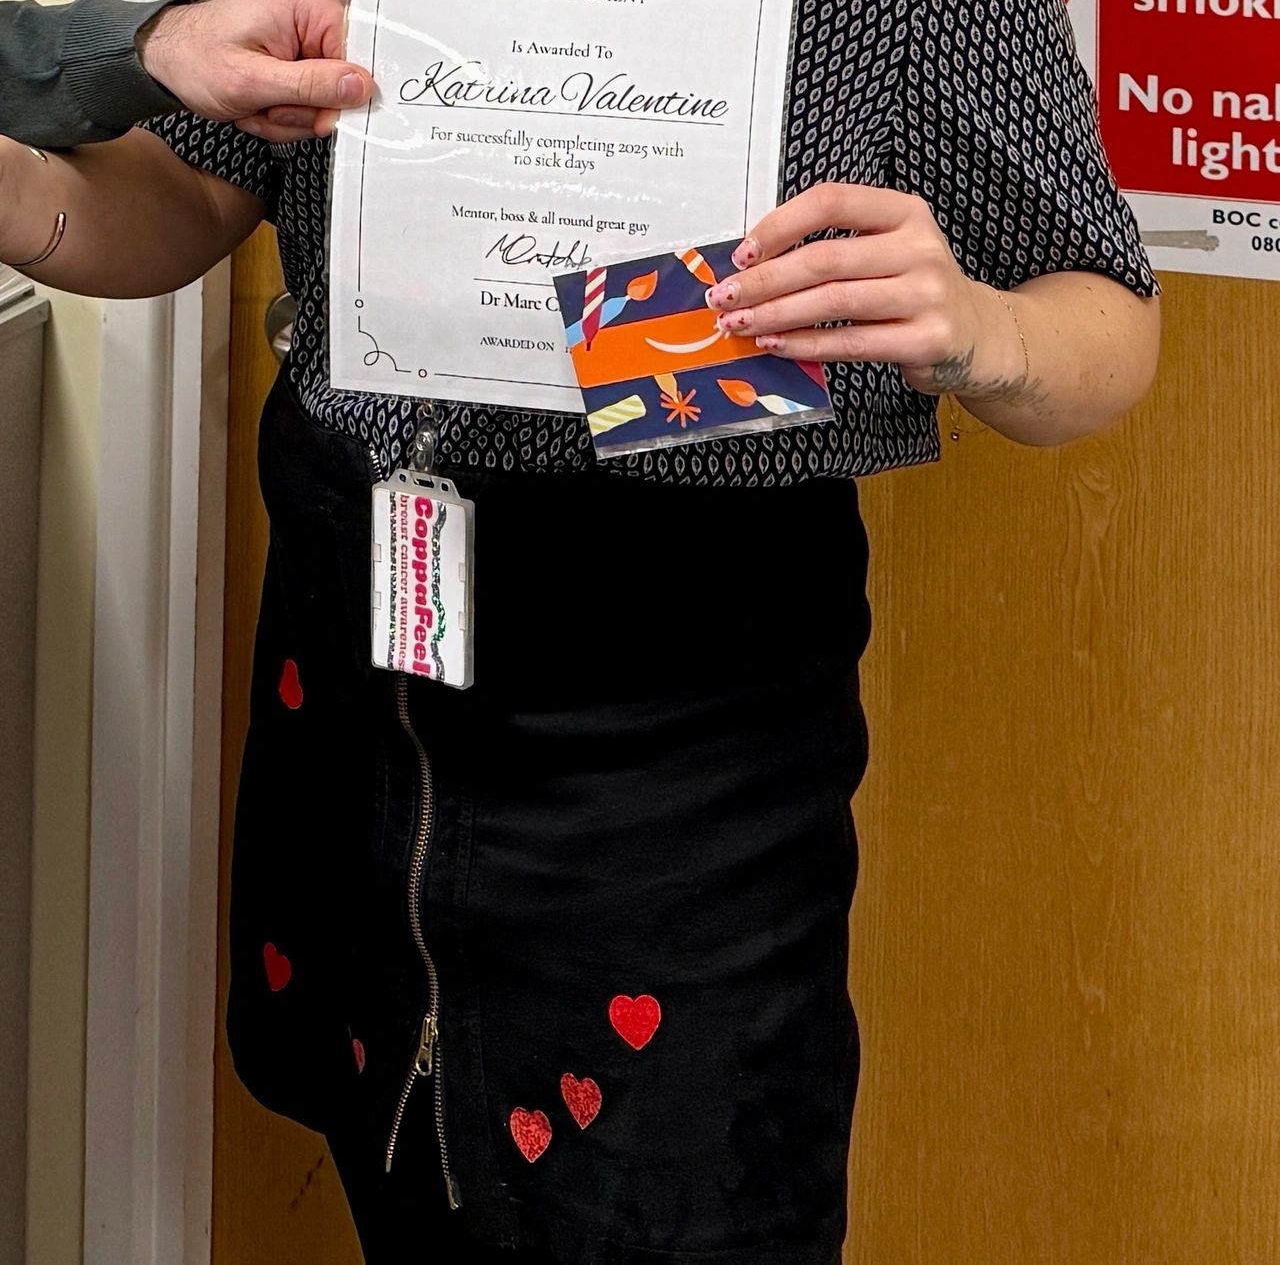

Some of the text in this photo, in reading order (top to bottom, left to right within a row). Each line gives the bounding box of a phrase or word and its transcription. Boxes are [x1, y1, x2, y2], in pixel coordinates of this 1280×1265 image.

[512, 40, 613, 59] Is Awarded To
[400, 61, 729, 119] Katrina Valentine
[1118, 72, 1193, 115] No
[430, 126, 684, 159] For successfully completing 2025 with
[1172, 126, 1280, 181] light
[514, 153, 596, 175] no sick days
[452, 205, 650, 236] Mentor, boss & all round great guy
[1212, 209, 1261, 227] BOC
[481, 291, 561, 312] Dr Marc C
[480, 337, 554, 351] AWARDED ON
[400, 495, 409, 540] breast
[400, 545, 408, 594] cancer
[412, 496, 433, 674] CoppaFeel
